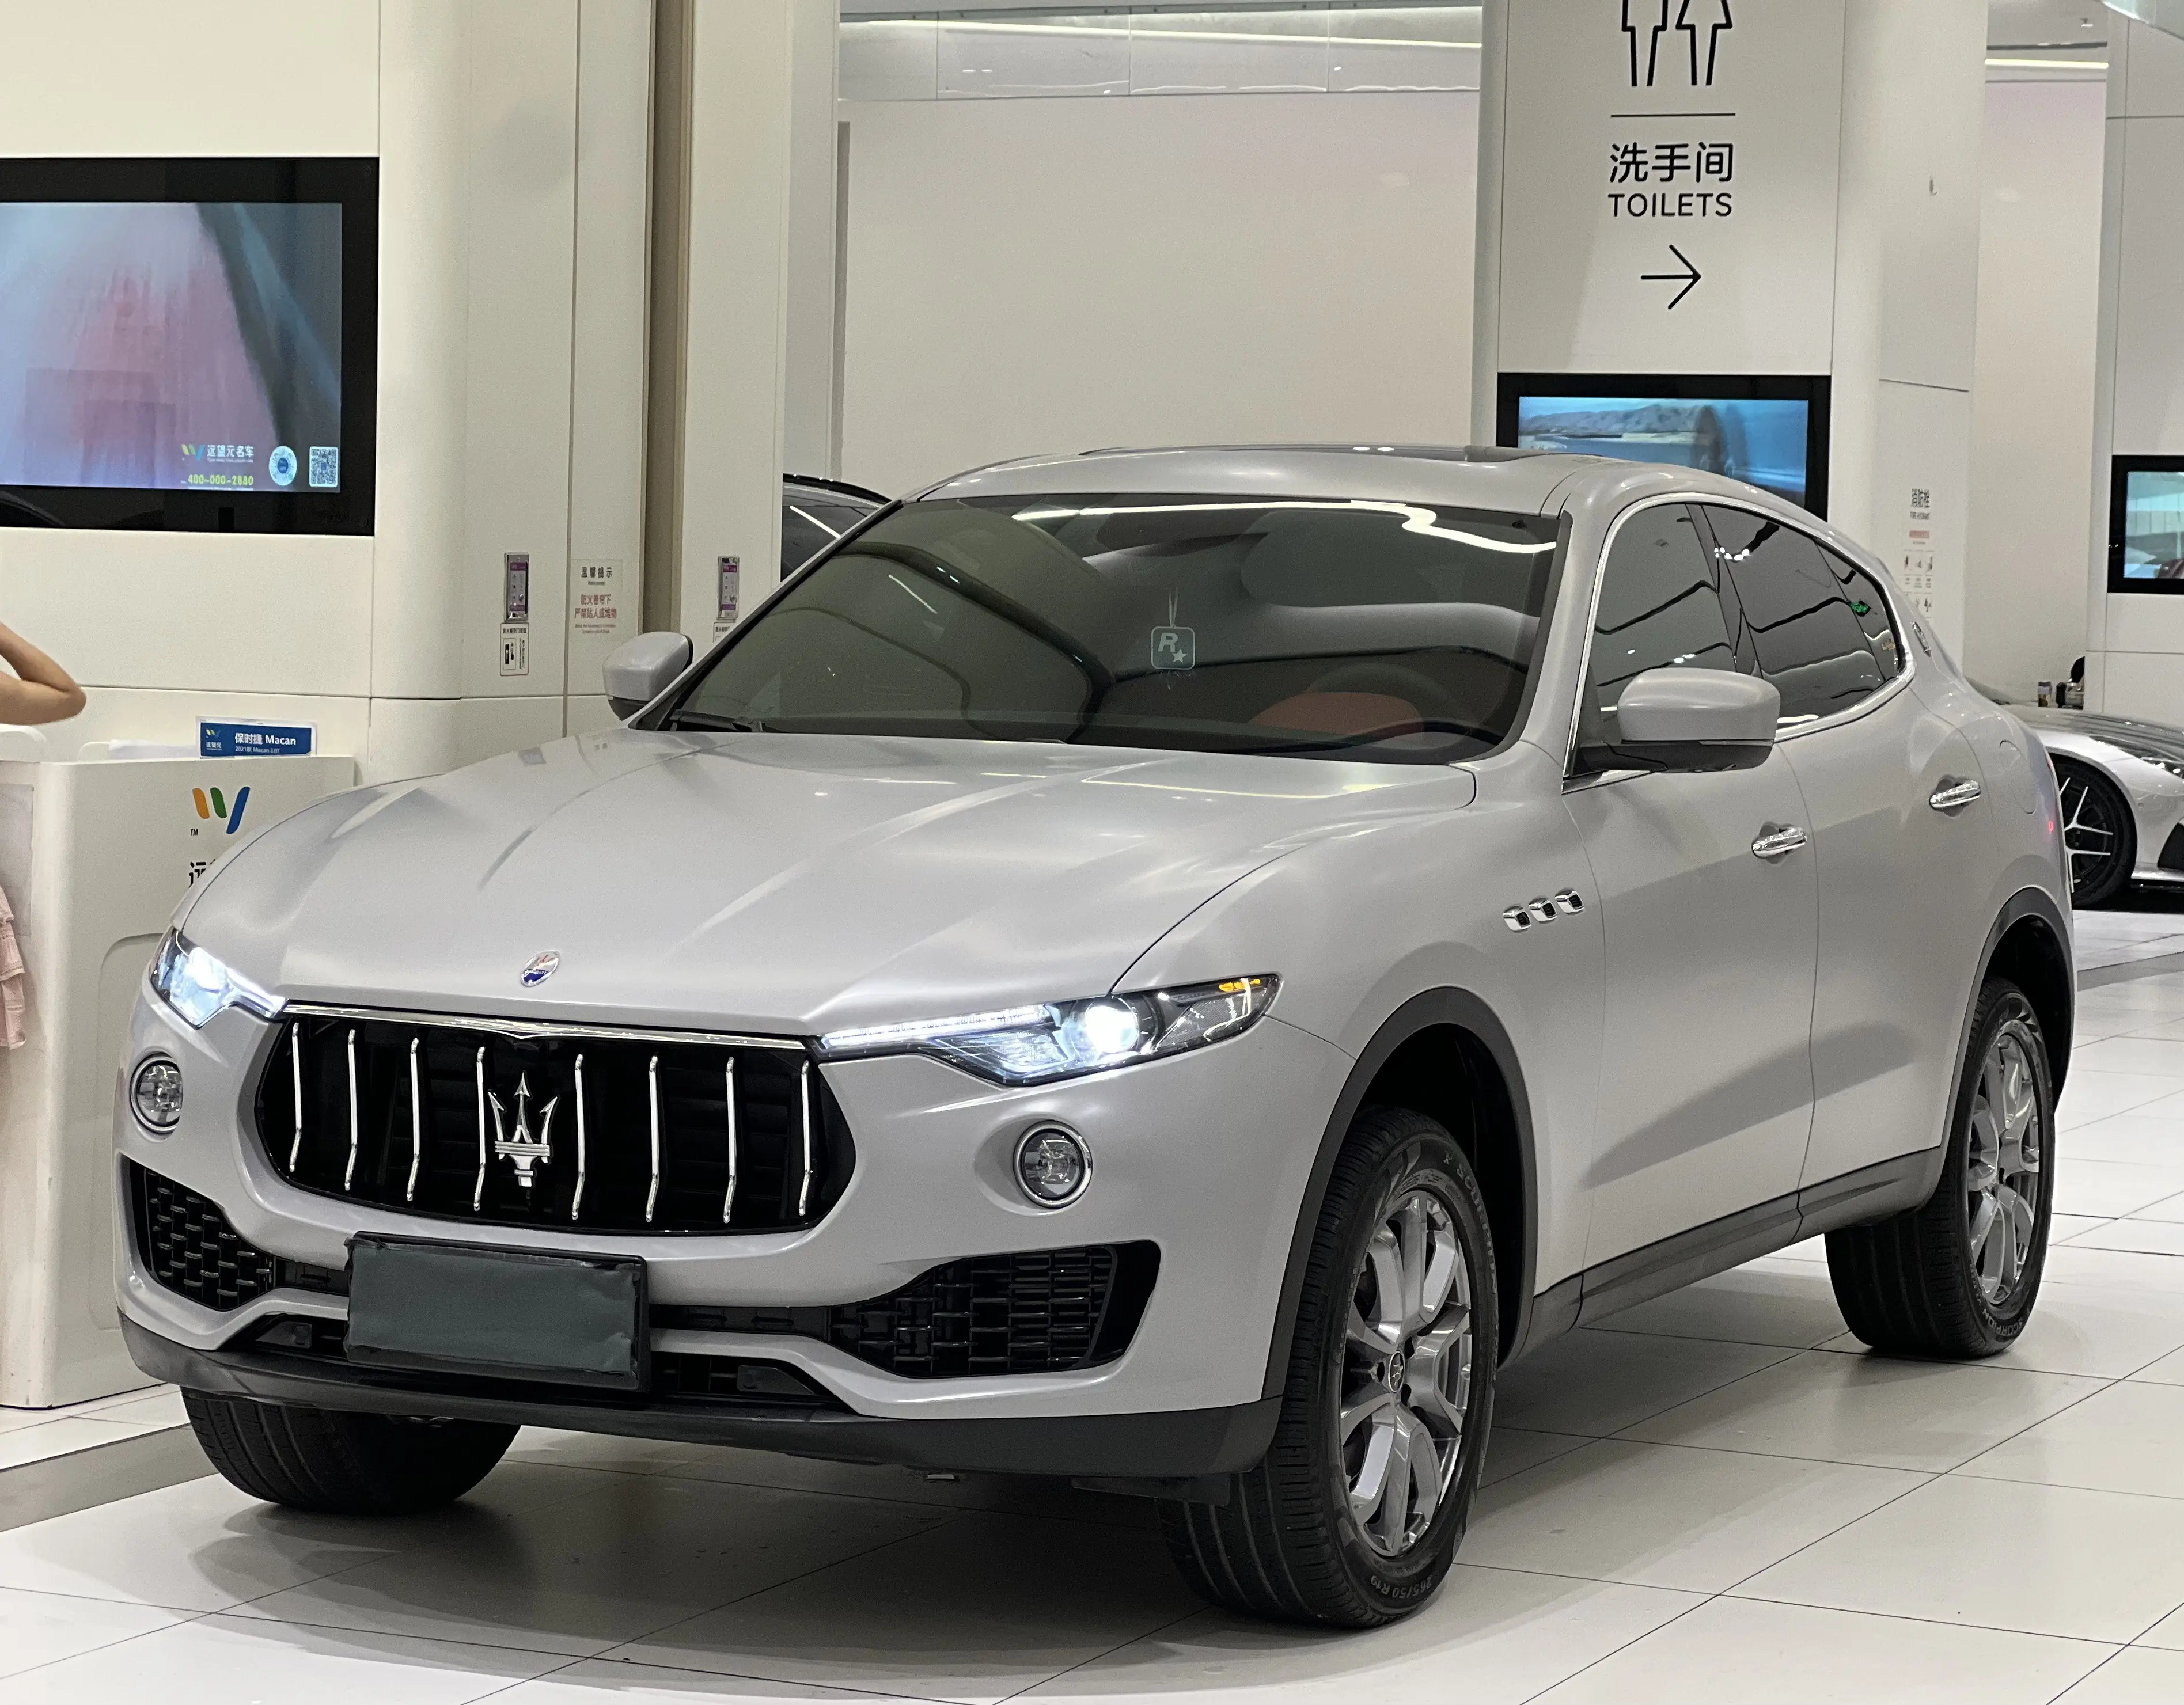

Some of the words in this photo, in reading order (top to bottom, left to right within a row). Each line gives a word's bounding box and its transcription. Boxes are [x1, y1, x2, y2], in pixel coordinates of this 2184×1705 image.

[1610, 142, 1733, 183] 洗手间
[1607, 193, 1732, 217] TOILETS
[1158, 632, 1178, 652] R
[235, 732, 263, 745] 保时捷
[266, 735, 296, 745] Macan
